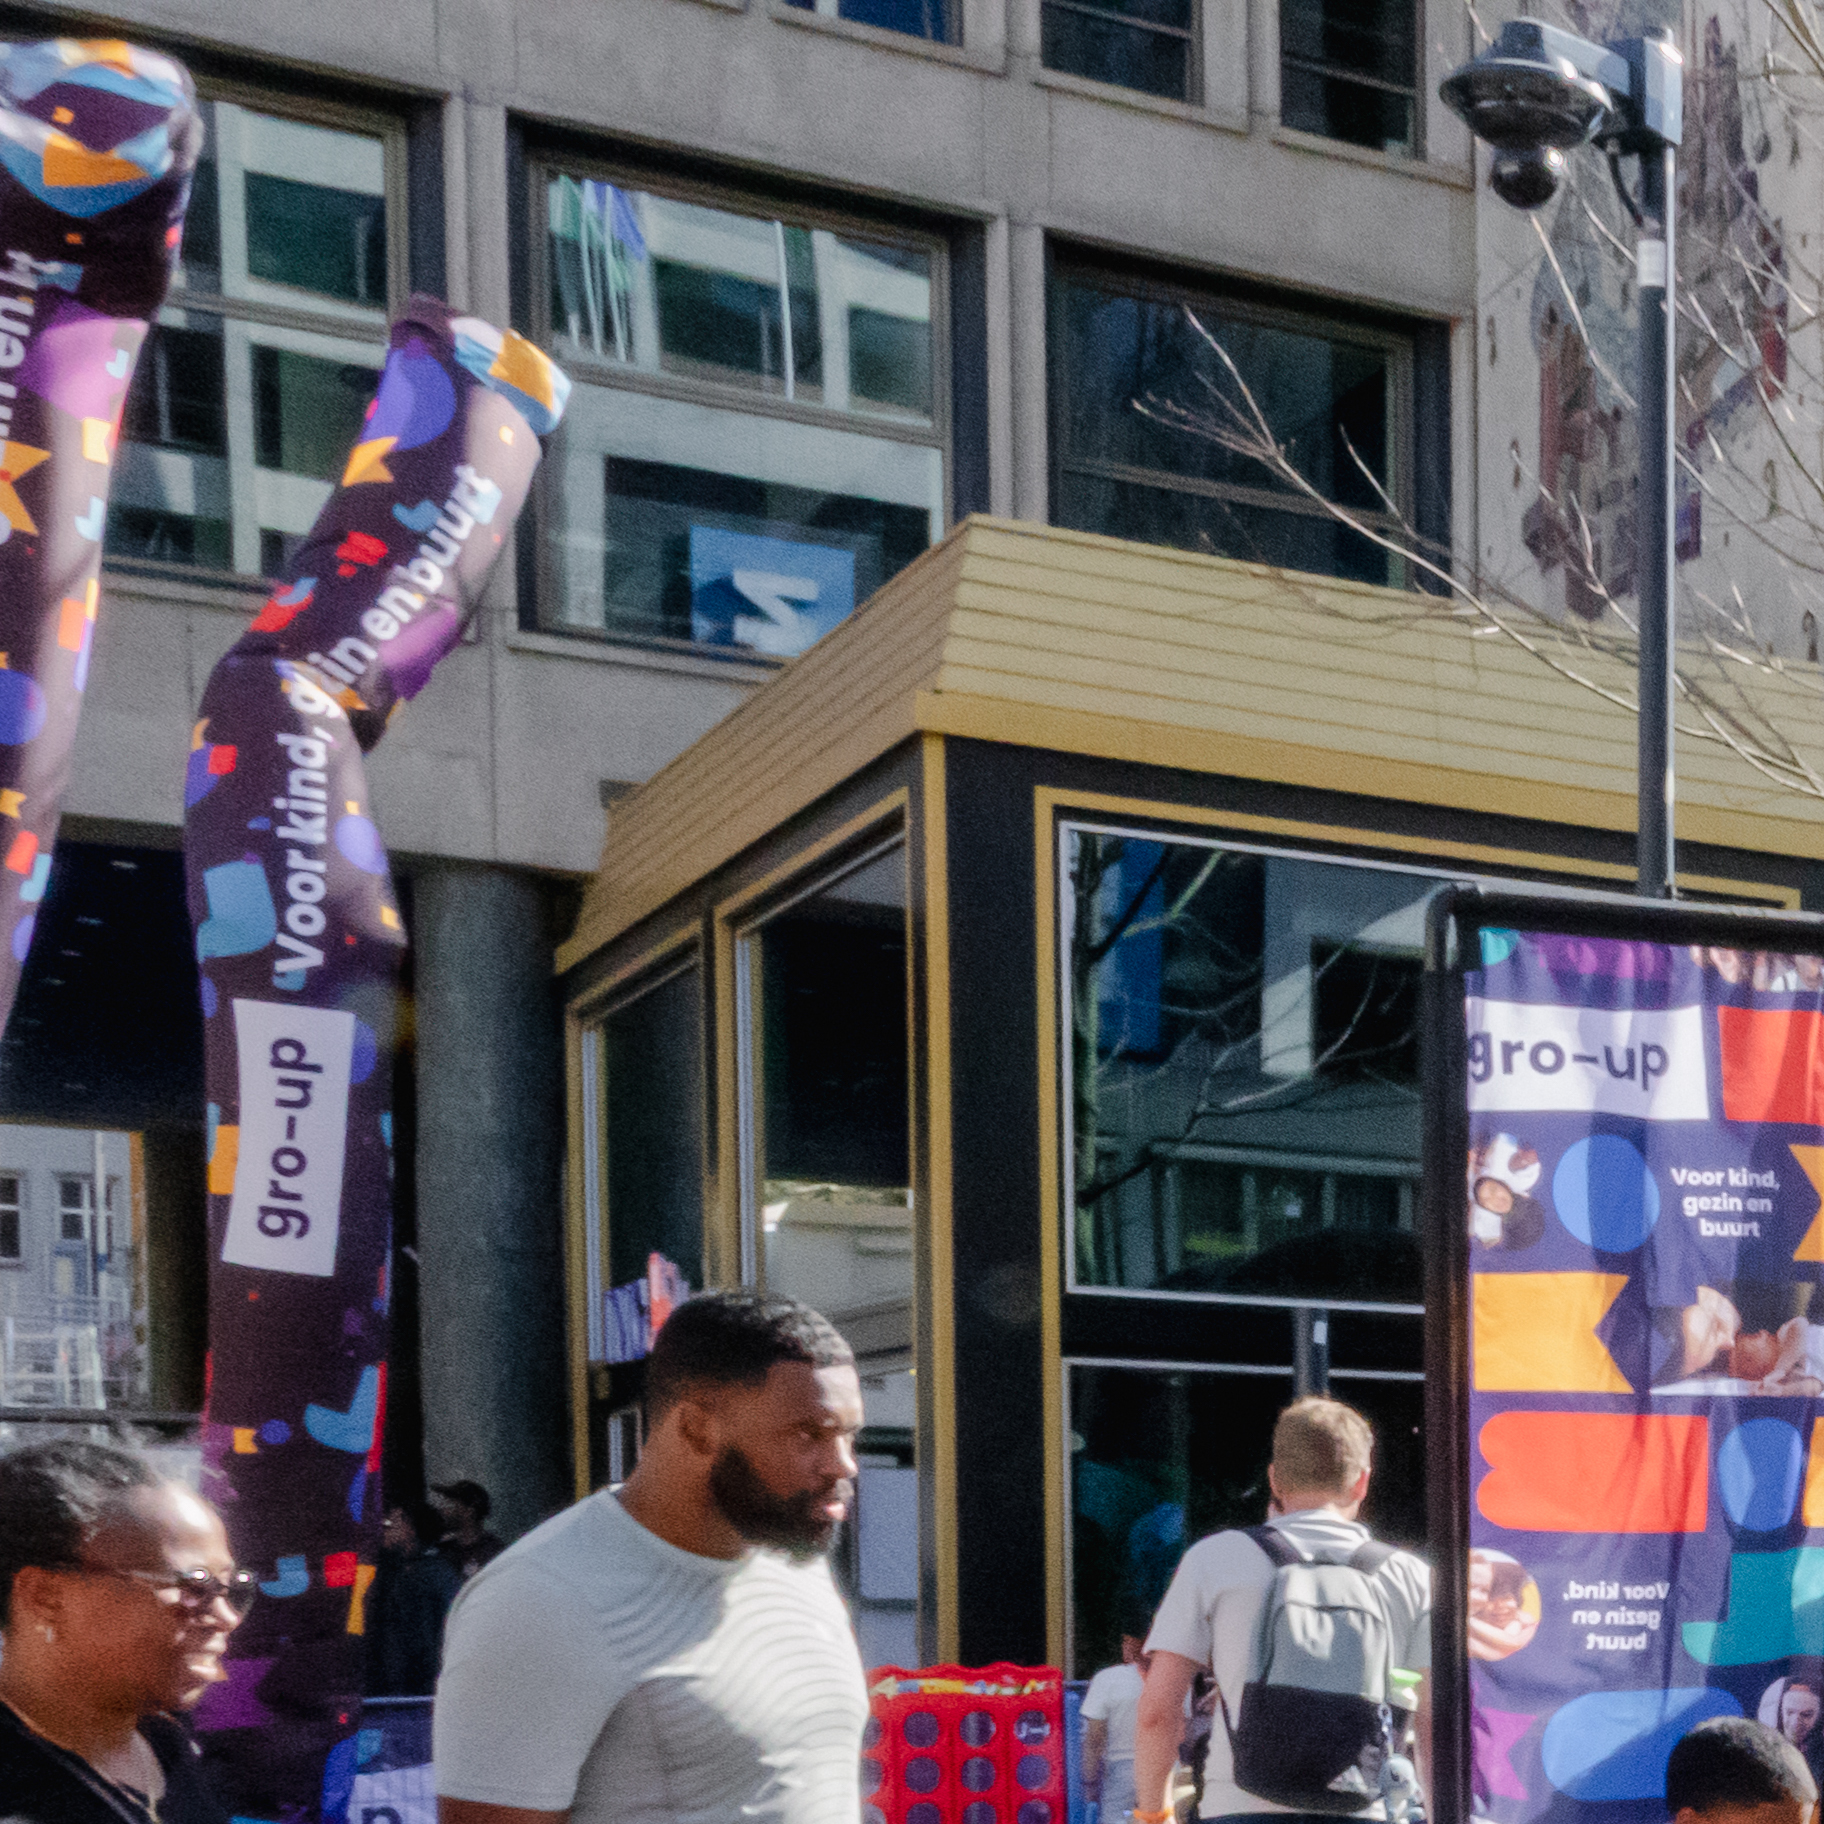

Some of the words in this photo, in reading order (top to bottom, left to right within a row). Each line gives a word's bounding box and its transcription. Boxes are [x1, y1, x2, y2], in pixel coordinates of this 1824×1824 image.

[388, 463, 498, 600] buurt
[361, 585, 427, 641] en
[274, 727, 334, 846] kind,
[274, 848, 330, 974] Voor
[1467, 1030, 1670, 1091] gro-up
[257, 1037, 324, 1240] gro-up
[1671, 1167, 1725, 1188] Voor
[1728, 1167, 1780, 1190] kind,
[1682, 1193, 1743, 1217] gezin
[1745, 1196, 1773, 1213] en
[1700, 1218, 1761, 1238] buurt
